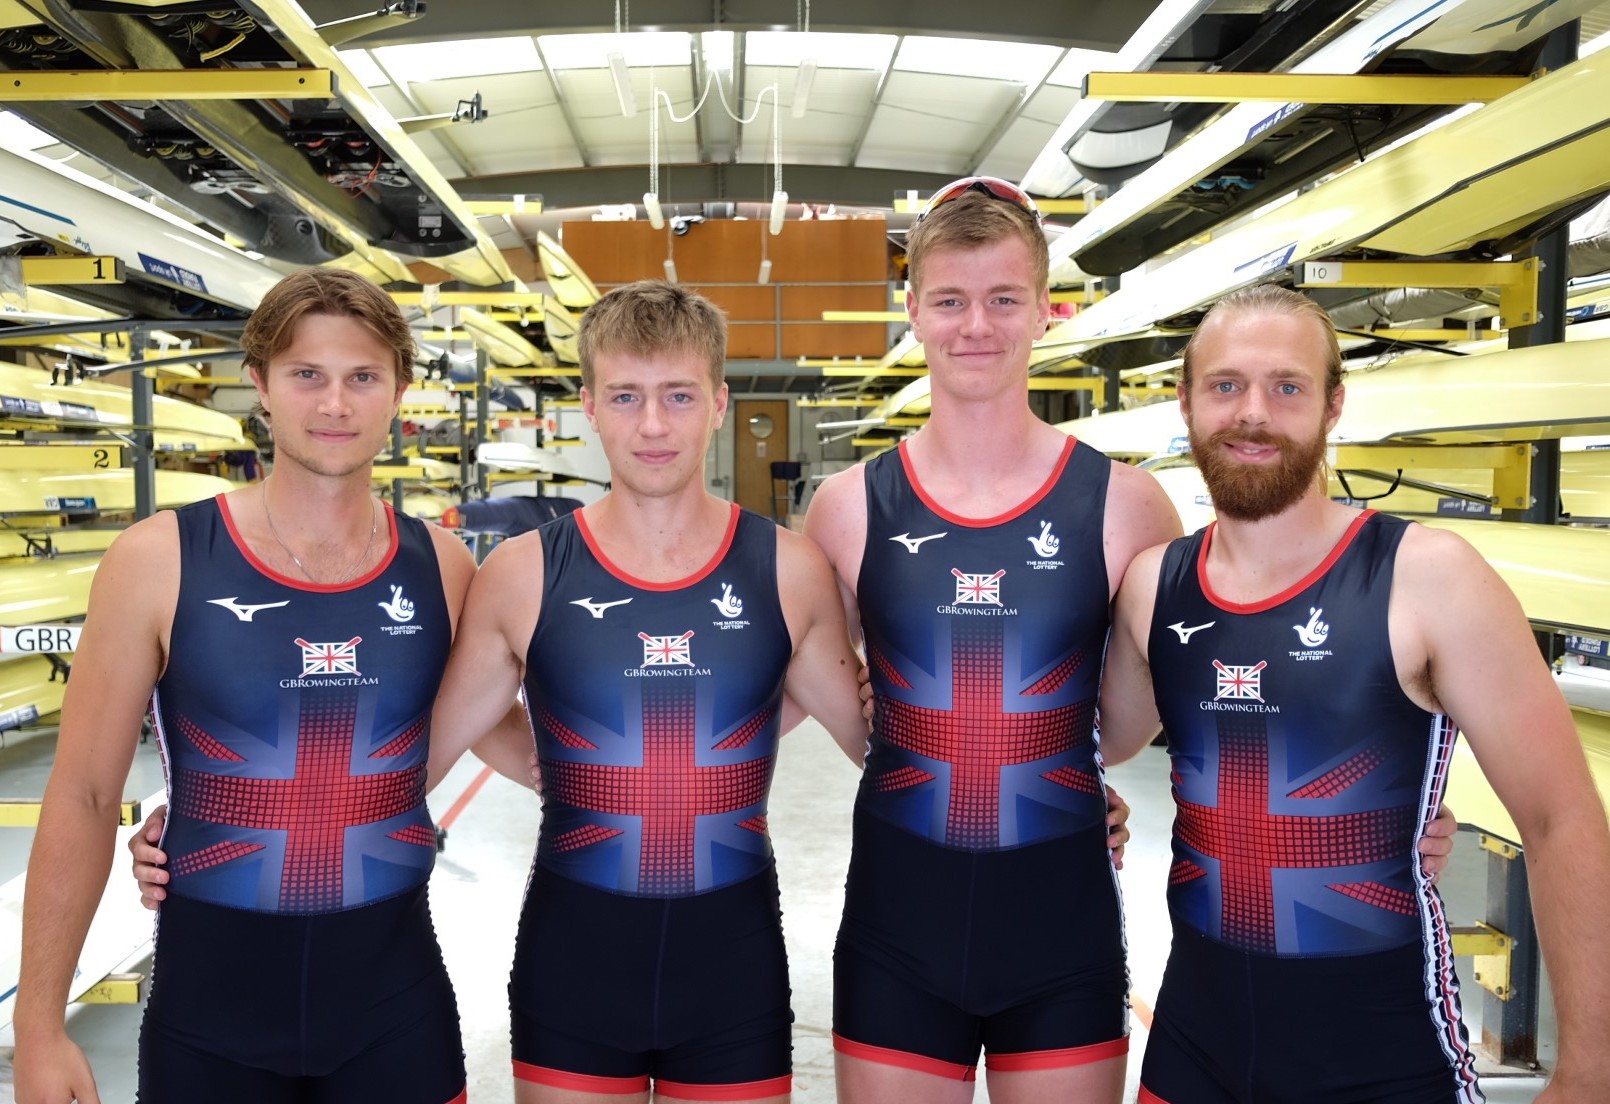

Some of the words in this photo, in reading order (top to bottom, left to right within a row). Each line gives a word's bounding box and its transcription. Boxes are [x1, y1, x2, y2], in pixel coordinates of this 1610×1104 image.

[93, 258, 106, 279] 1
[1313, 267, 1327, 279] 10
[94, 449, 109, 468] 2
[15, 628, 72, 651] GBR
